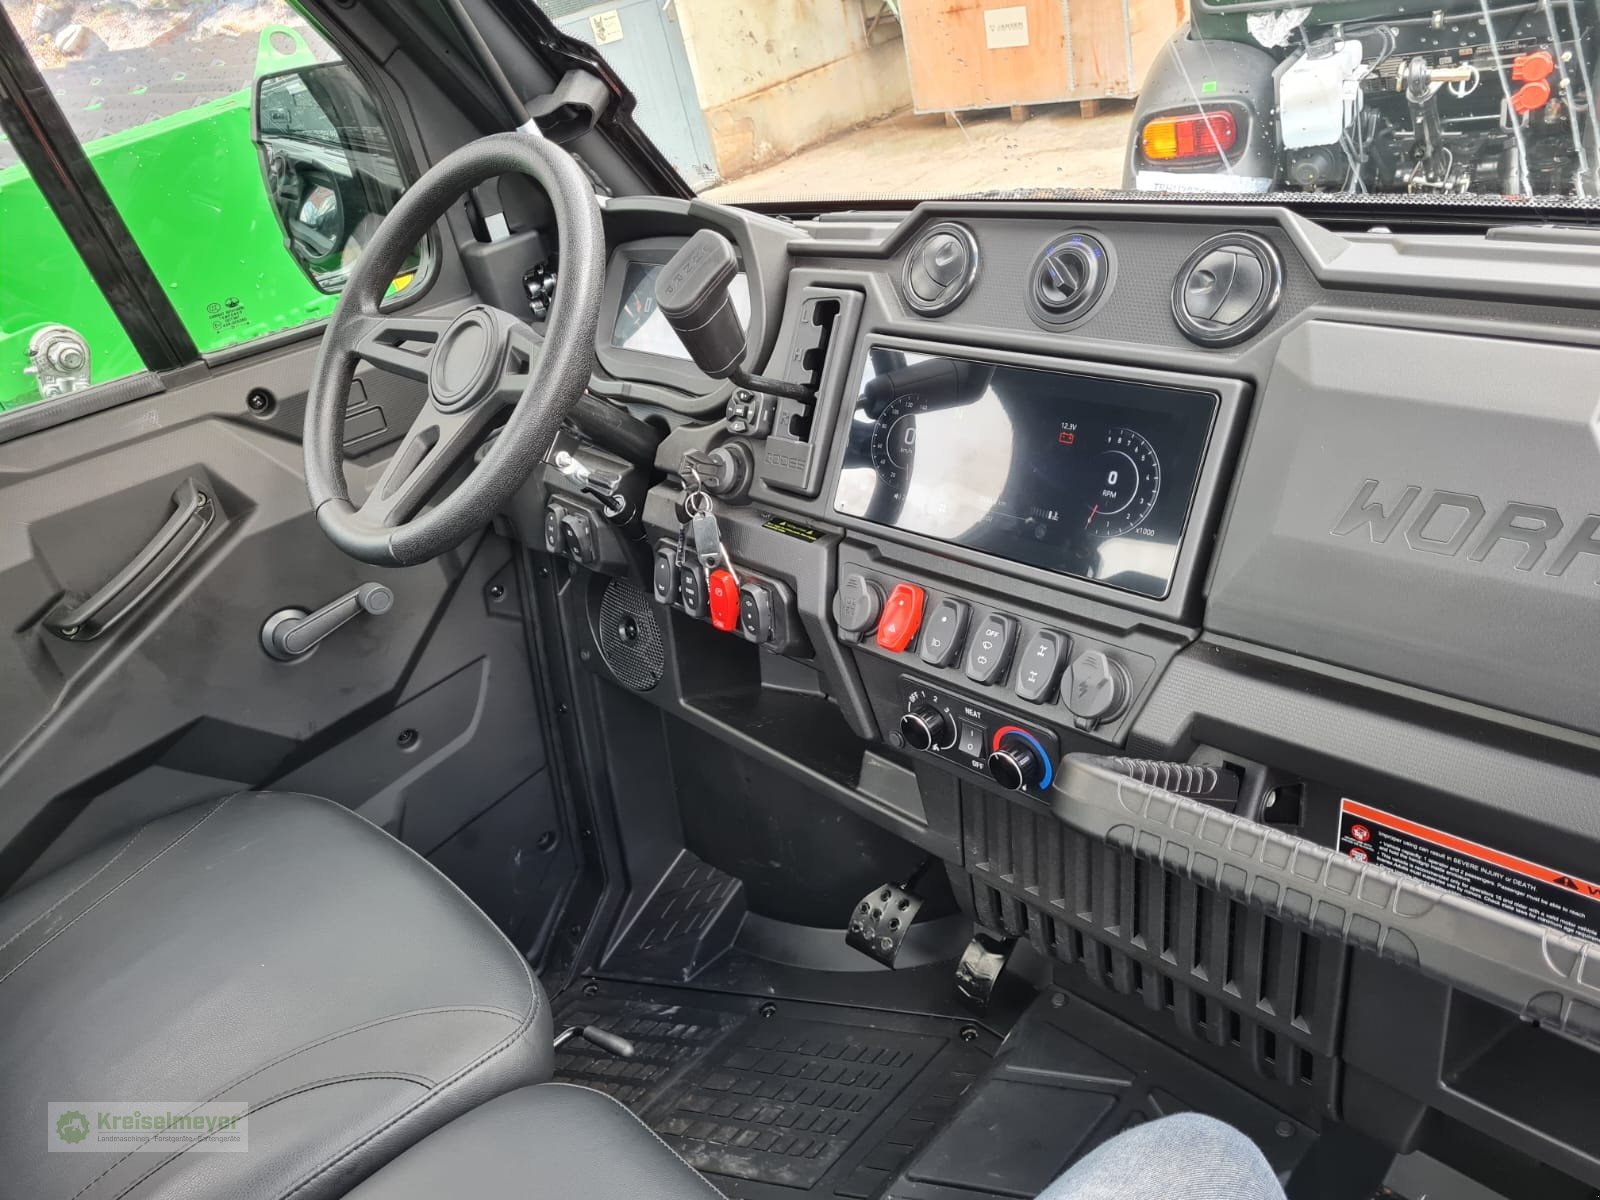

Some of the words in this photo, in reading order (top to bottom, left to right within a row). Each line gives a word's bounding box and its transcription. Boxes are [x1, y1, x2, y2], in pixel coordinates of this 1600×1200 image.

[1061, 422, 1078, 431] 12.3V
[904, 427, 916, 445] 0
[1107, 470, 1118, 485] 0
[1102, 489, 1117, 499] RPM
[985, 628, 1000, 639] OFF
[908, 691, 919, 703] OFF
[921, 690, 926, 698] 1
[933, 695, 938, 703] 2
[964, 706, 982, 719] HEAT
[971, 759, 985, 770] OFF
[1418, 846, 1429, 854] can
[1430, 850, 1446, 859] result
[1453, 857, 1479, 870] SEVERE
[1480, 866, 1504, 879] INJURY
[1428, 858, 1448, 868] operator
[1497, 882, 1526, 896] Passenger
[1526, 894, 1540, 902] must
[1549, 902, 1561, 910] able
[1569, 909, 1586, 919] reach
[1483, 895, 1501, 906] Check
[1514, 902, 1528, 910] older
[1529, 907, 1540, 915] with
[1546, 913, 1559, 922] valid
[1560, 919, 1576, 928] motor
